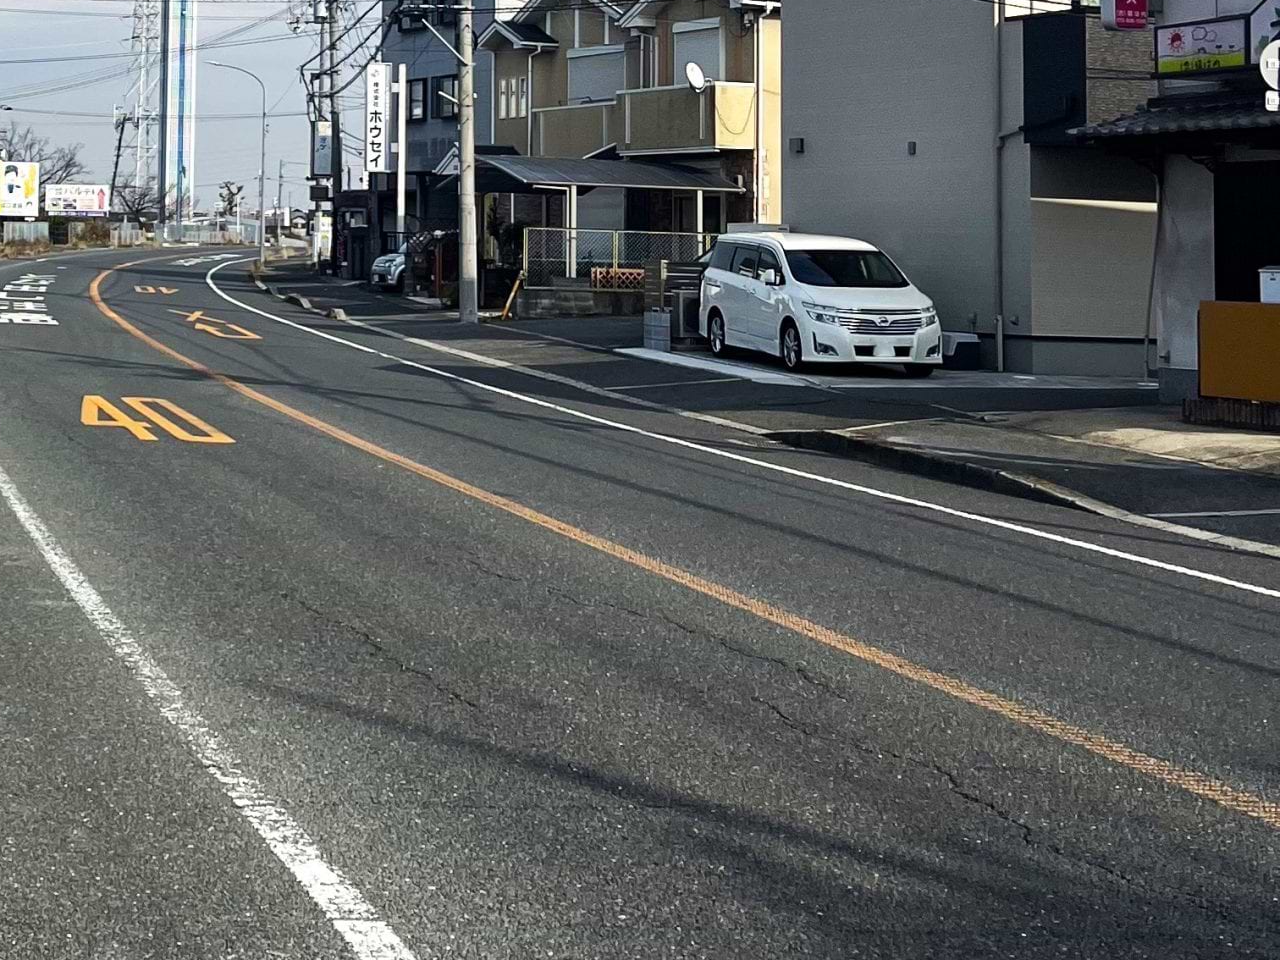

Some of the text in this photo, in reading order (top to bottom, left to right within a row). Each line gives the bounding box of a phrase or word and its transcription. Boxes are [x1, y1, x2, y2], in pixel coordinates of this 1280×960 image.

[369, 109, 383, 168] ホウセイ
[80, 394, 237, 444] 40
